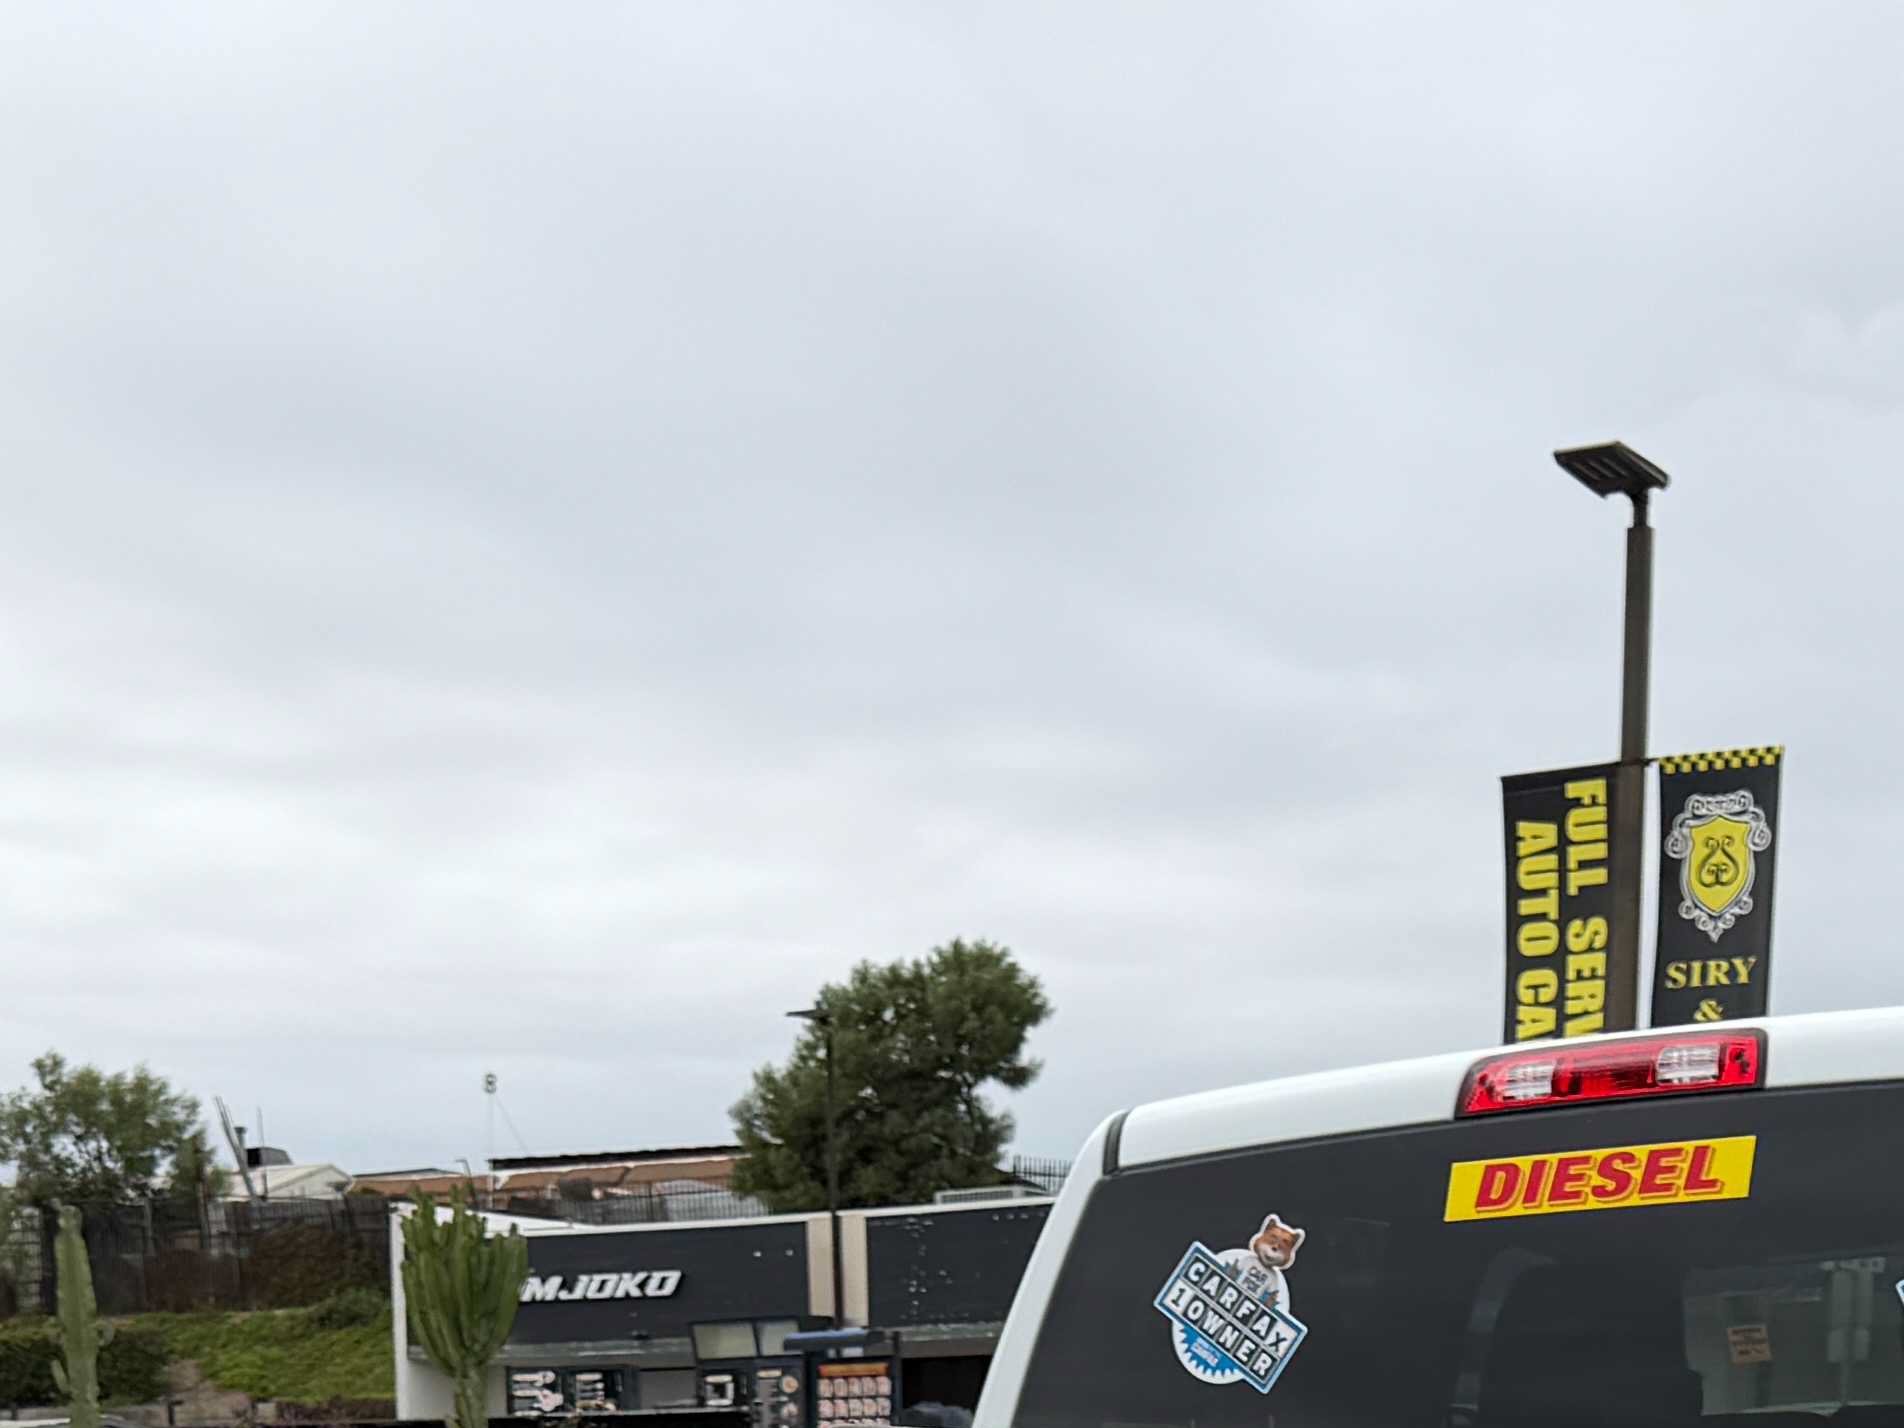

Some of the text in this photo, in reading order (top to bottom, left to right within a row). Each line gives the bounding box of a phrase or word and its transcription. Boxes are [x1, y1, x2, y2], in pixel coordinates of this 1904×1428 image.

[1563, 778, 1608, 897] FULL
[1516, 821, 1560, 957] AUTO
[1664, 955, 1757, 989] SIRY
[1693, 998, 1724, 1021] &
[1475, 1145, 1725, 1213] DIESEL
[1186, 1300, 1273, 1376] OWNER
[1188, 1261, 1287, 1354] CARFAX
